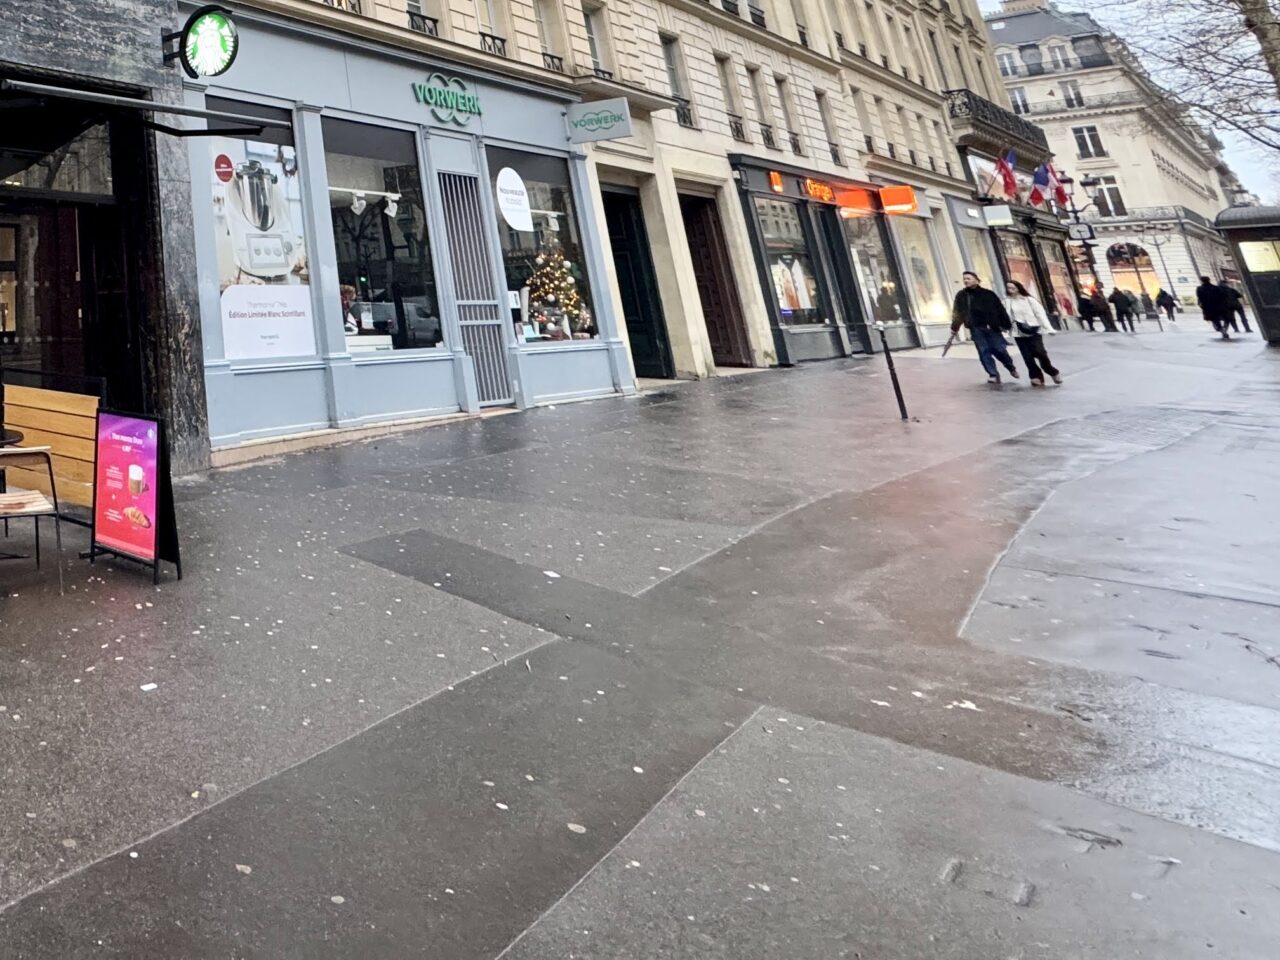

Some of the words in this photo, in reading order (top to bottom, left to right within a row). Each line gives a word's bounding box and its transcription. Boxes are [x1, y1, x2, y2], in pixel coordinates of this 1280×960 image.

[411, 82, 483, 116] VORWERK
[572, 113, 624, 128] VORWERK
[228, 310, 247, 319] Édition
